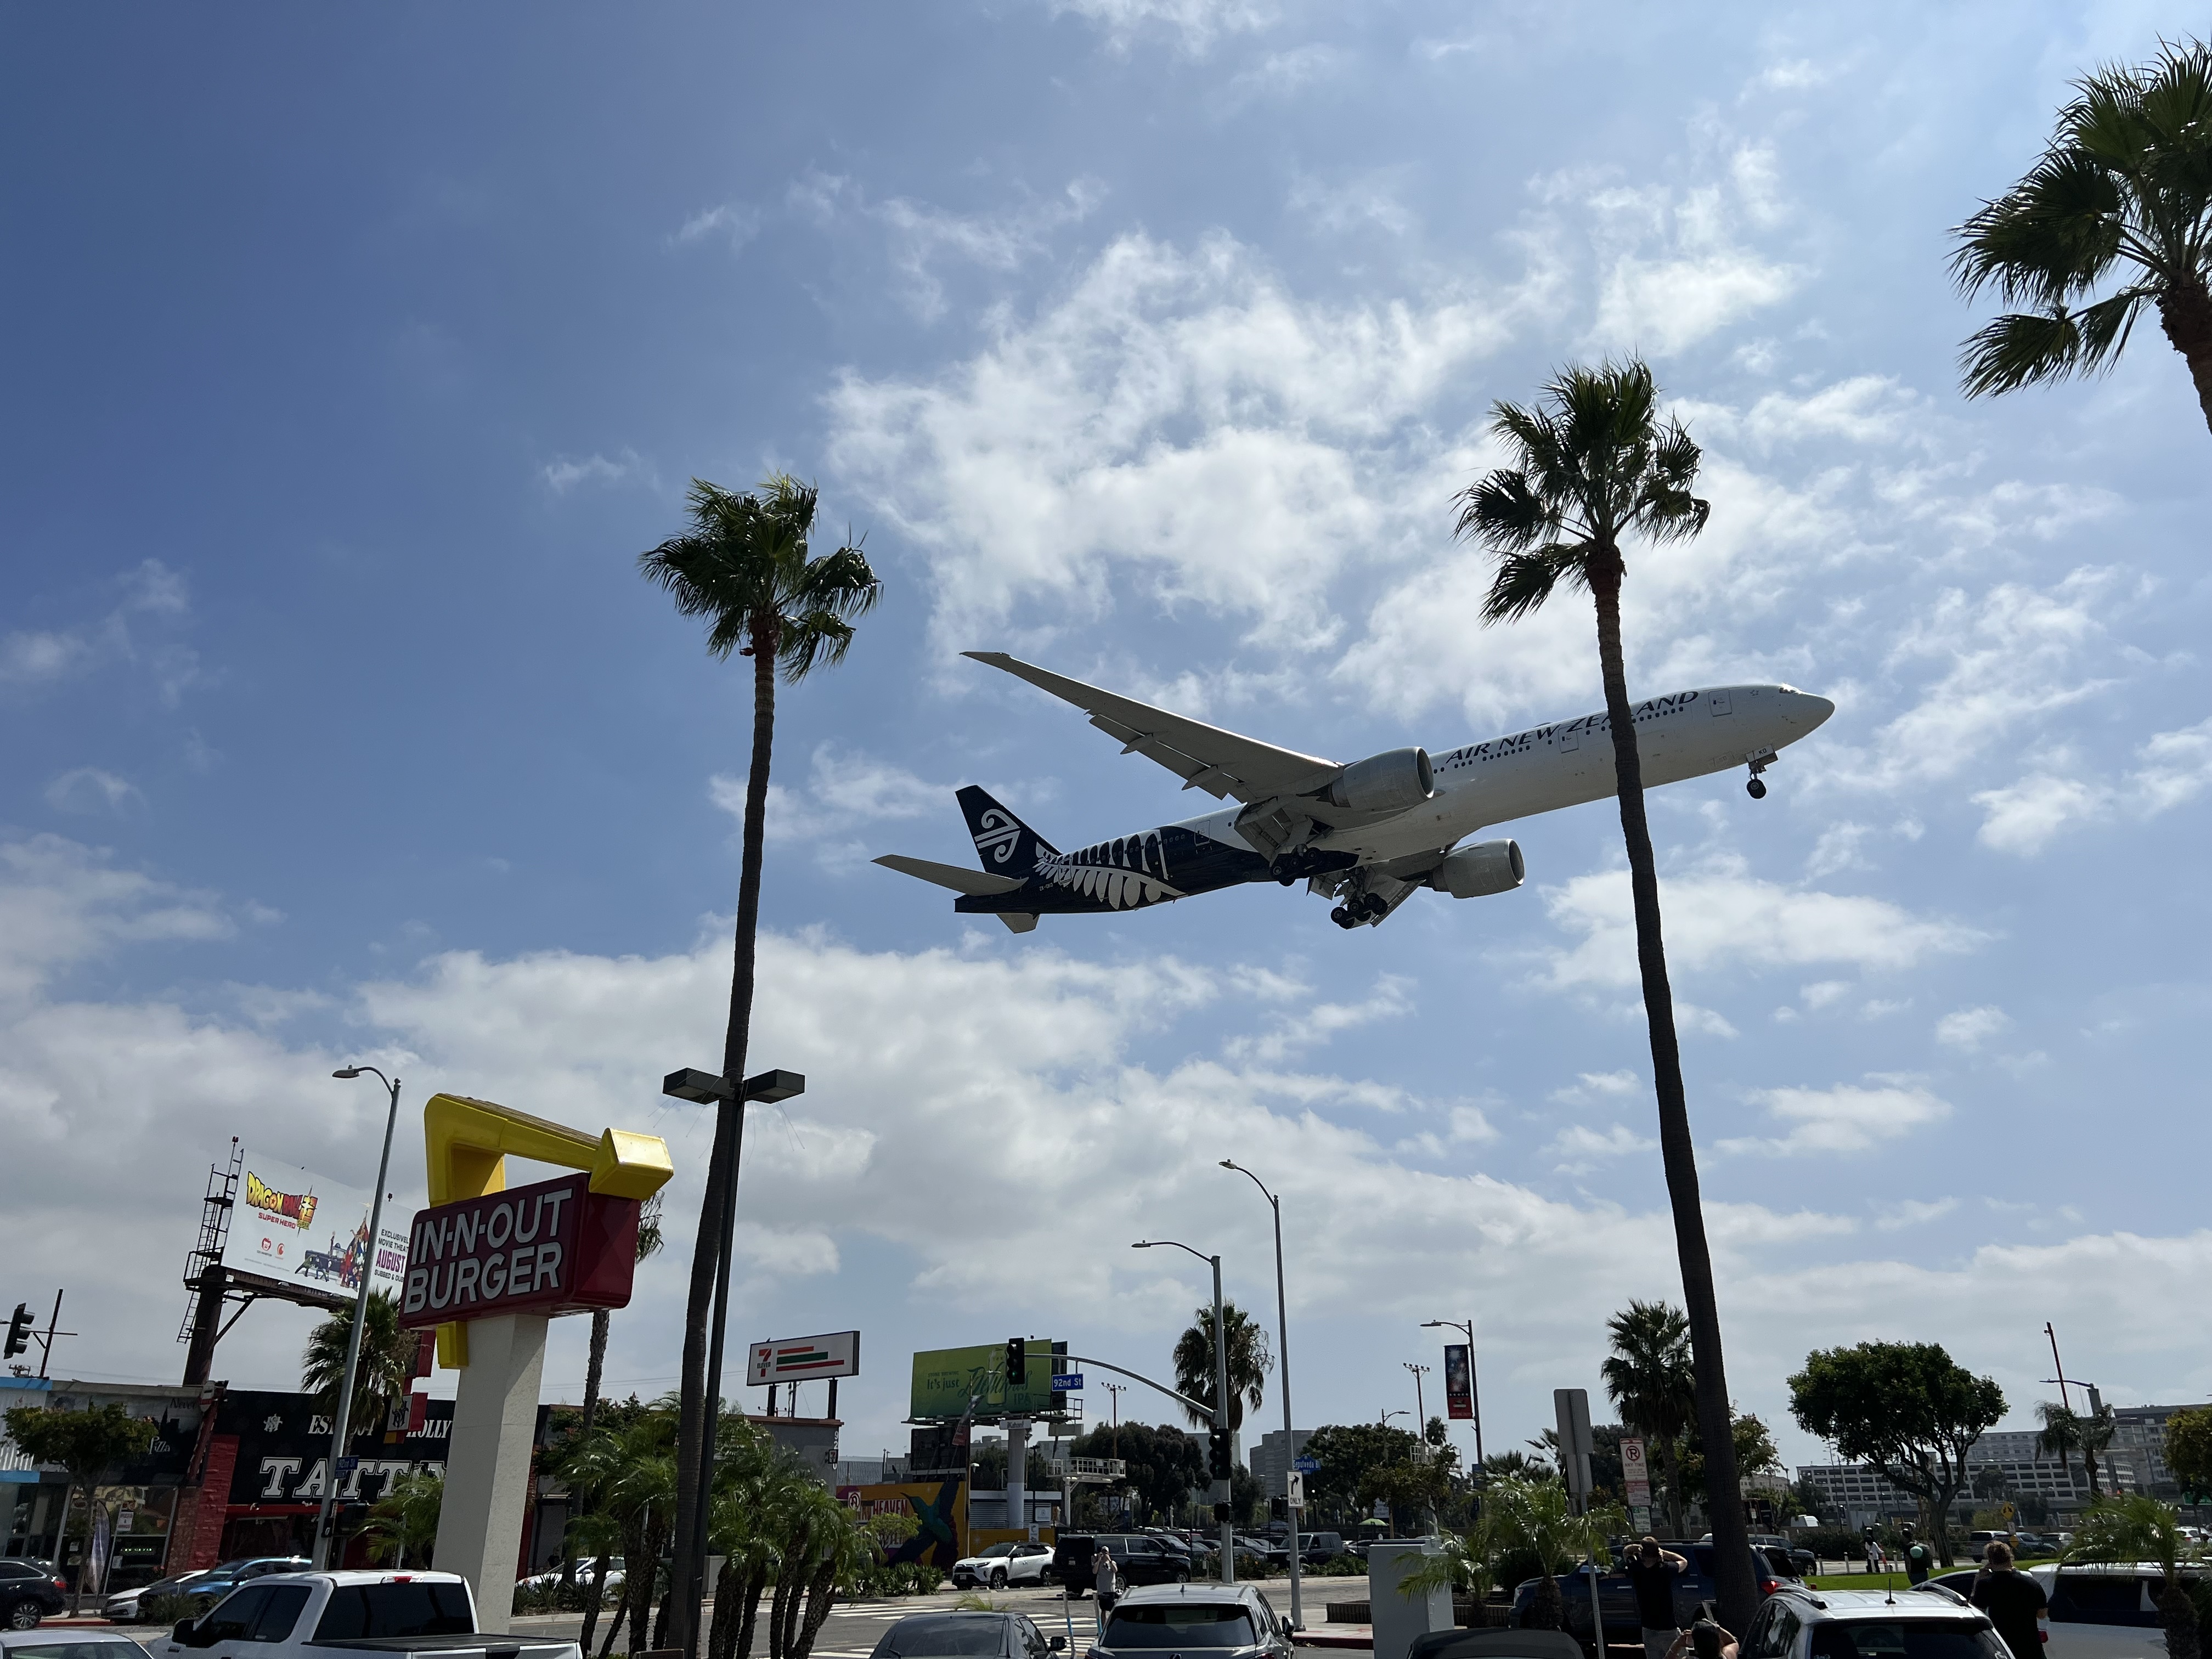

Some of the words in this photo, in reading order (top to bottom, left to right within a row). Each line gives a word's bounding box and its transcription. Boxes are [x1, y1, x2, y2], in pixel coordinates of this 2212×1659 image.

[1445, 742, 1491, 764] AIR
[1499, 724, 1561, 751] NEW
[1566, 691, 1699, 733] ZEAND
[246, 1171, 284, 1215] DRAGON
[258, 1212, 280, 1224] SUPER
[279, 1219, 296, 1229] HERO
[411, 1188, 573, 1265] IN-N-OUT
[378, 1237, 393, 1248] MOVIE
[376, 1248, 406, 1274] AUGUST
[404, 1242, 562, 1313] BURGER
[758, 1348, 772, 1378] 7
[927, 1378, 941, 1390] It's
[943, 1377, 960, 1392] just
[1053, 1378, 1071, 1387] 92nd
[1074, 1378, 1082, 1386] St
[1013, 1392, 1032, 1406] IPA
[1293, 1459, 1314, 1469] Sepulveda
